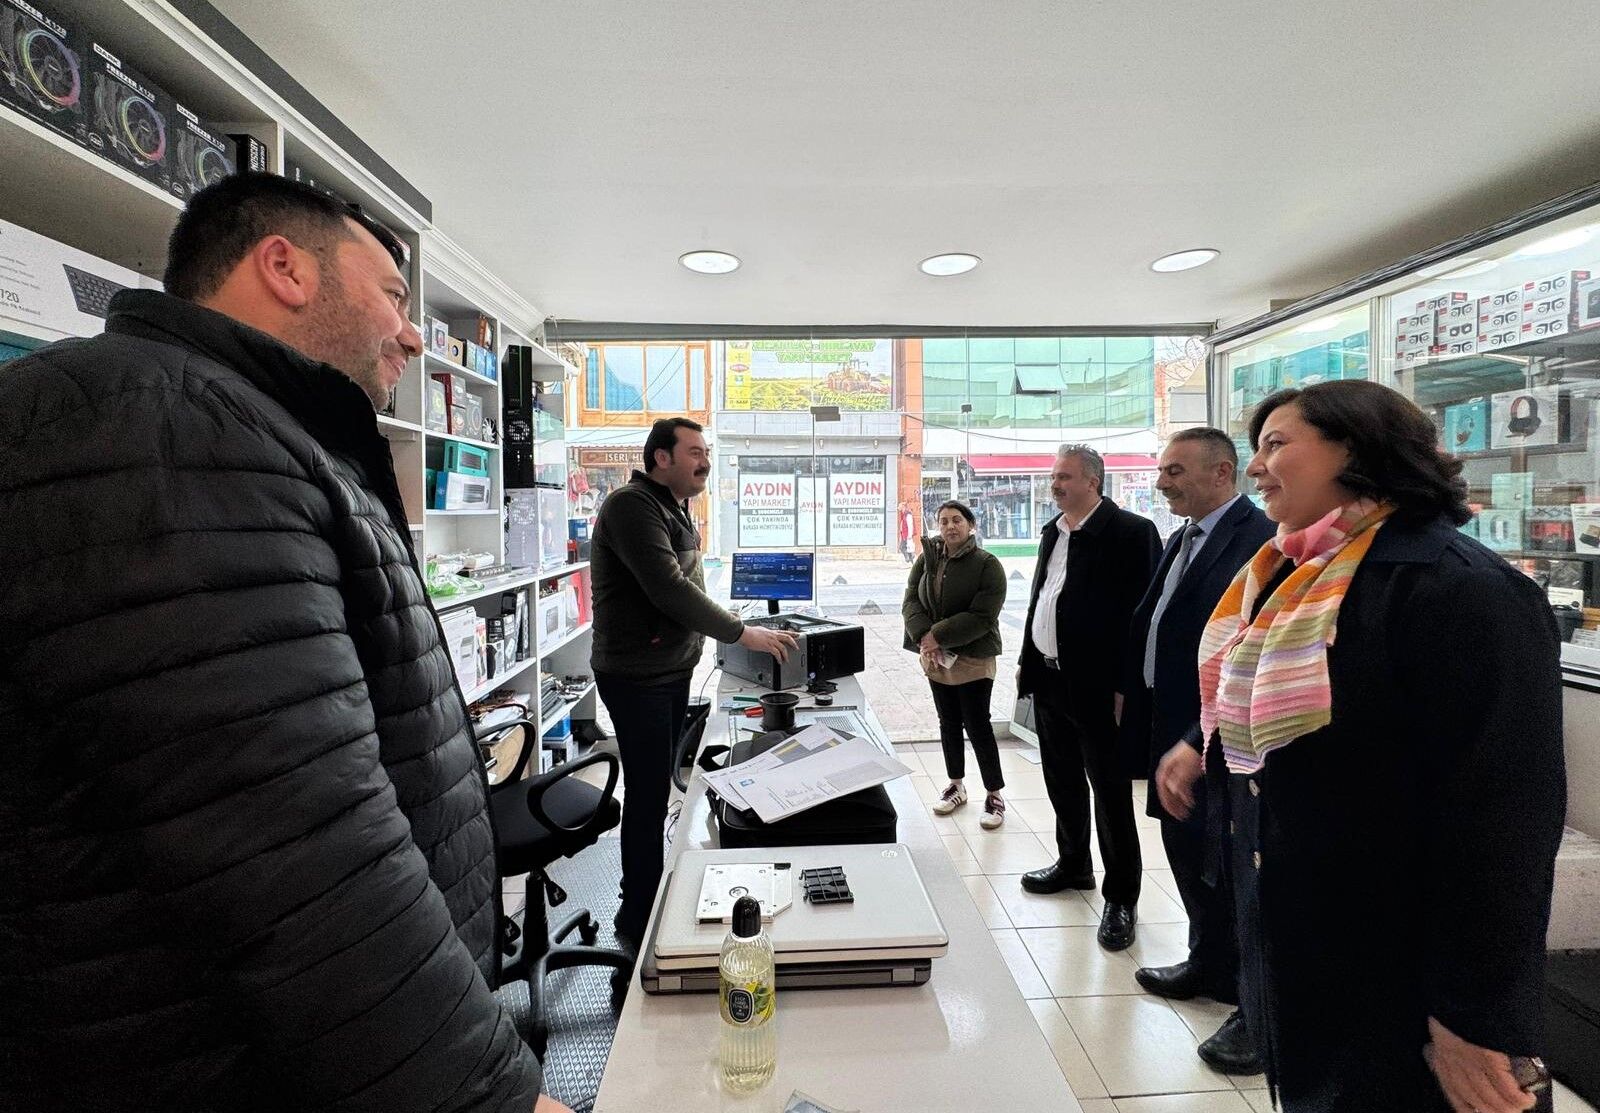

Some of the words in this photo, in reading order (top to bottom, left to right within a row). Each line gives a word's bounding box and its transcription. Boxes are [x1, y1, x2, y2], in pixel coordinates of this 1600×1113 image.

[106, 63, 138, 89] FREEZER
[744, 483, 792, 496] AYDIN
[834, 482, 881, 495] AYDIN
[834, 498, 849, 506] YAPI
[850, 498, 880, 506] MARKET
